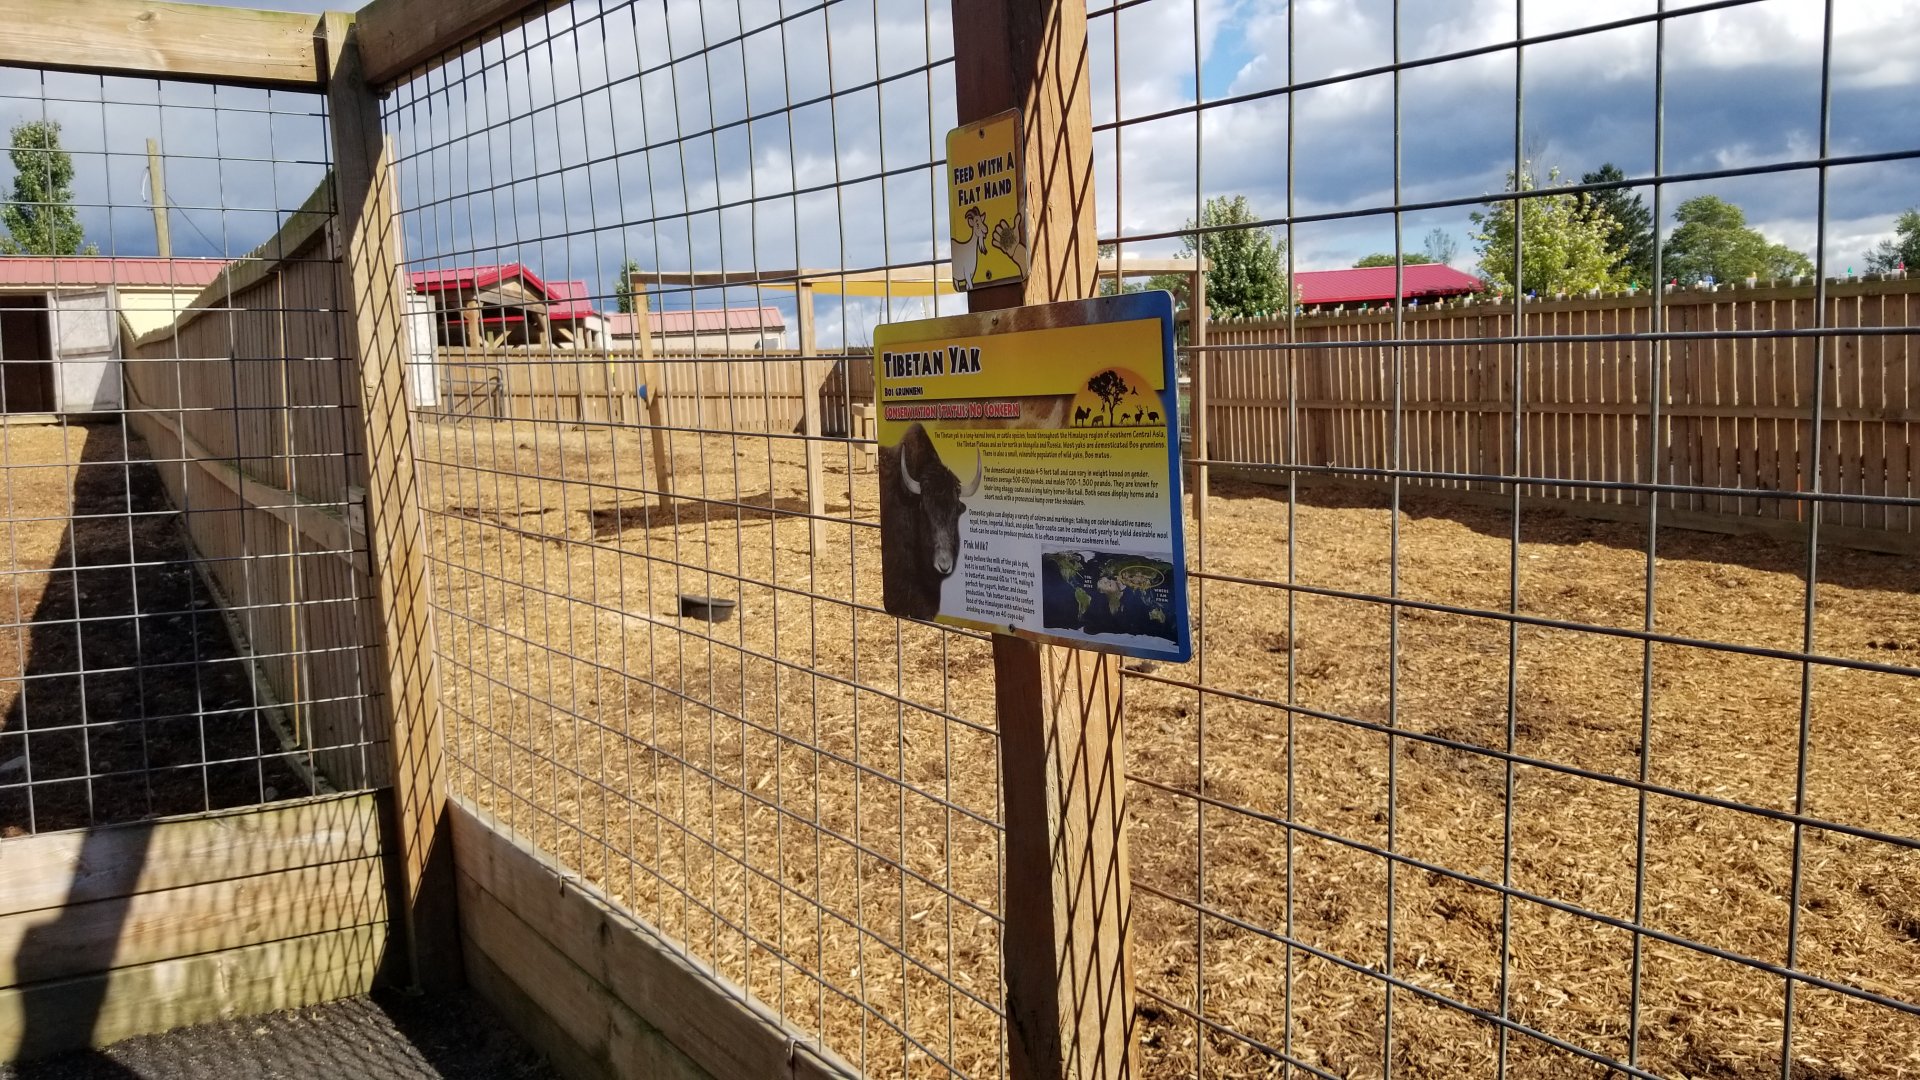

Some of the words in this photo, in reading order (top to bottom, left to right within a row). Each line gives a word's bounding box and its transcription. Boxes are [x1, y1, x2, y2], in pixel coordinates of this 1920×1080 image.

[954, 165, 974, 185] FEED
[978, 156, 1003, 178] WITH
[1006, 151, 1015, 171] A
[958, 186, 981, 207] FLAT
[984, 178, 1012, 200] HAND
[883, 351, 944, 378] TIBETAN
[948, 346, 981, 374] YAK
[1110, 430, 1132, 438] southern
[1133, 430, 1152, 438] Central
[1094, 440, 1128, 448] domesticated
[1109, 469, 1123, 477] based
[1113, 479, 1125, 489] They
[1134, 480, 1150, 488] known
[1111, 489, 1129, 499] display
[1130, 490, 1144, 498] horns
[1110, 518, 1134, 527] indicative
[1119, 528, 1132, 539] yield
[1132, 529, 1156, 539] desirable
